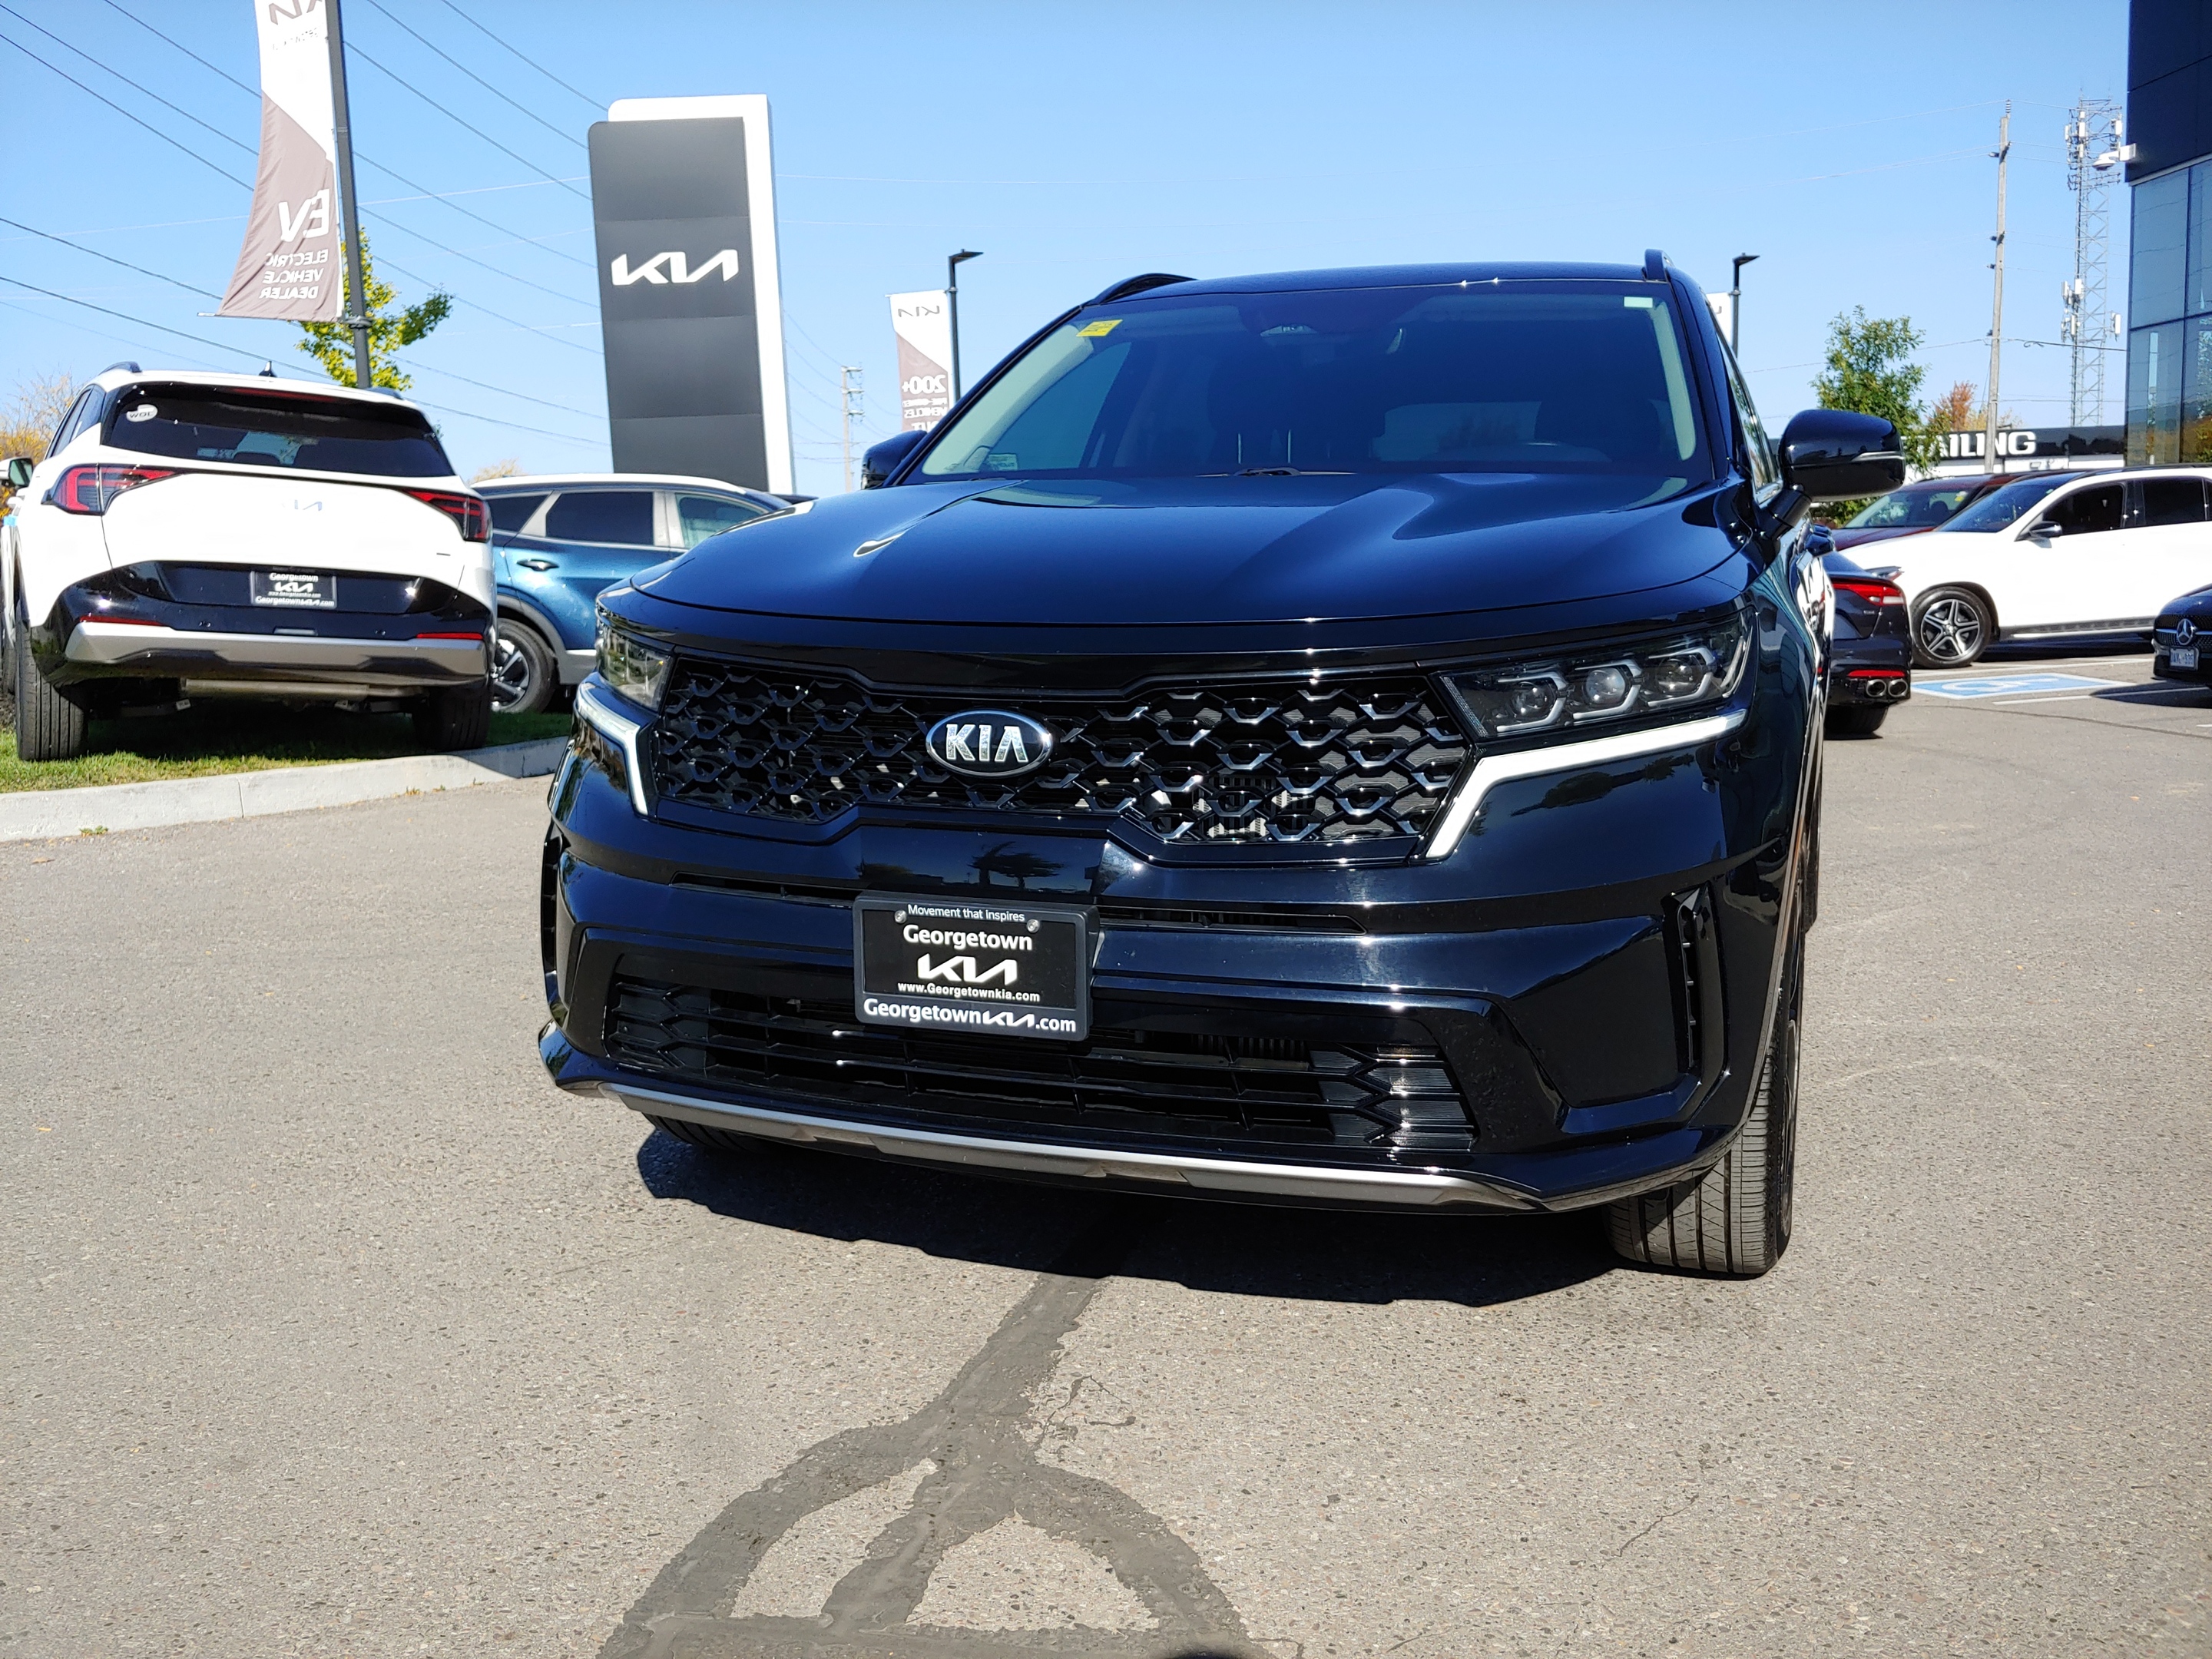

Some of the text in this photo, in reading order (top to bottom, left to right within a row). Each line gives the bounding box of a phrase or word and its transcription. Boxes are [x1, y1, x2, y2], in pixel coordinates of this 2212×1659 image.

[611, 249, 740, 286] KIA
[269, 572, 319, 582] Georgetown
[274, 581, 313, 593] KIA
[945, 724, 1029, 763] KIA
[908, 904, 1025, 922] Movement that inspires
[903, 924, 1032, 951] Georgetown
[917, 953, 1018, 985] KIA
[897, 982, 1041, 1002] www.Georgetownkia.com
